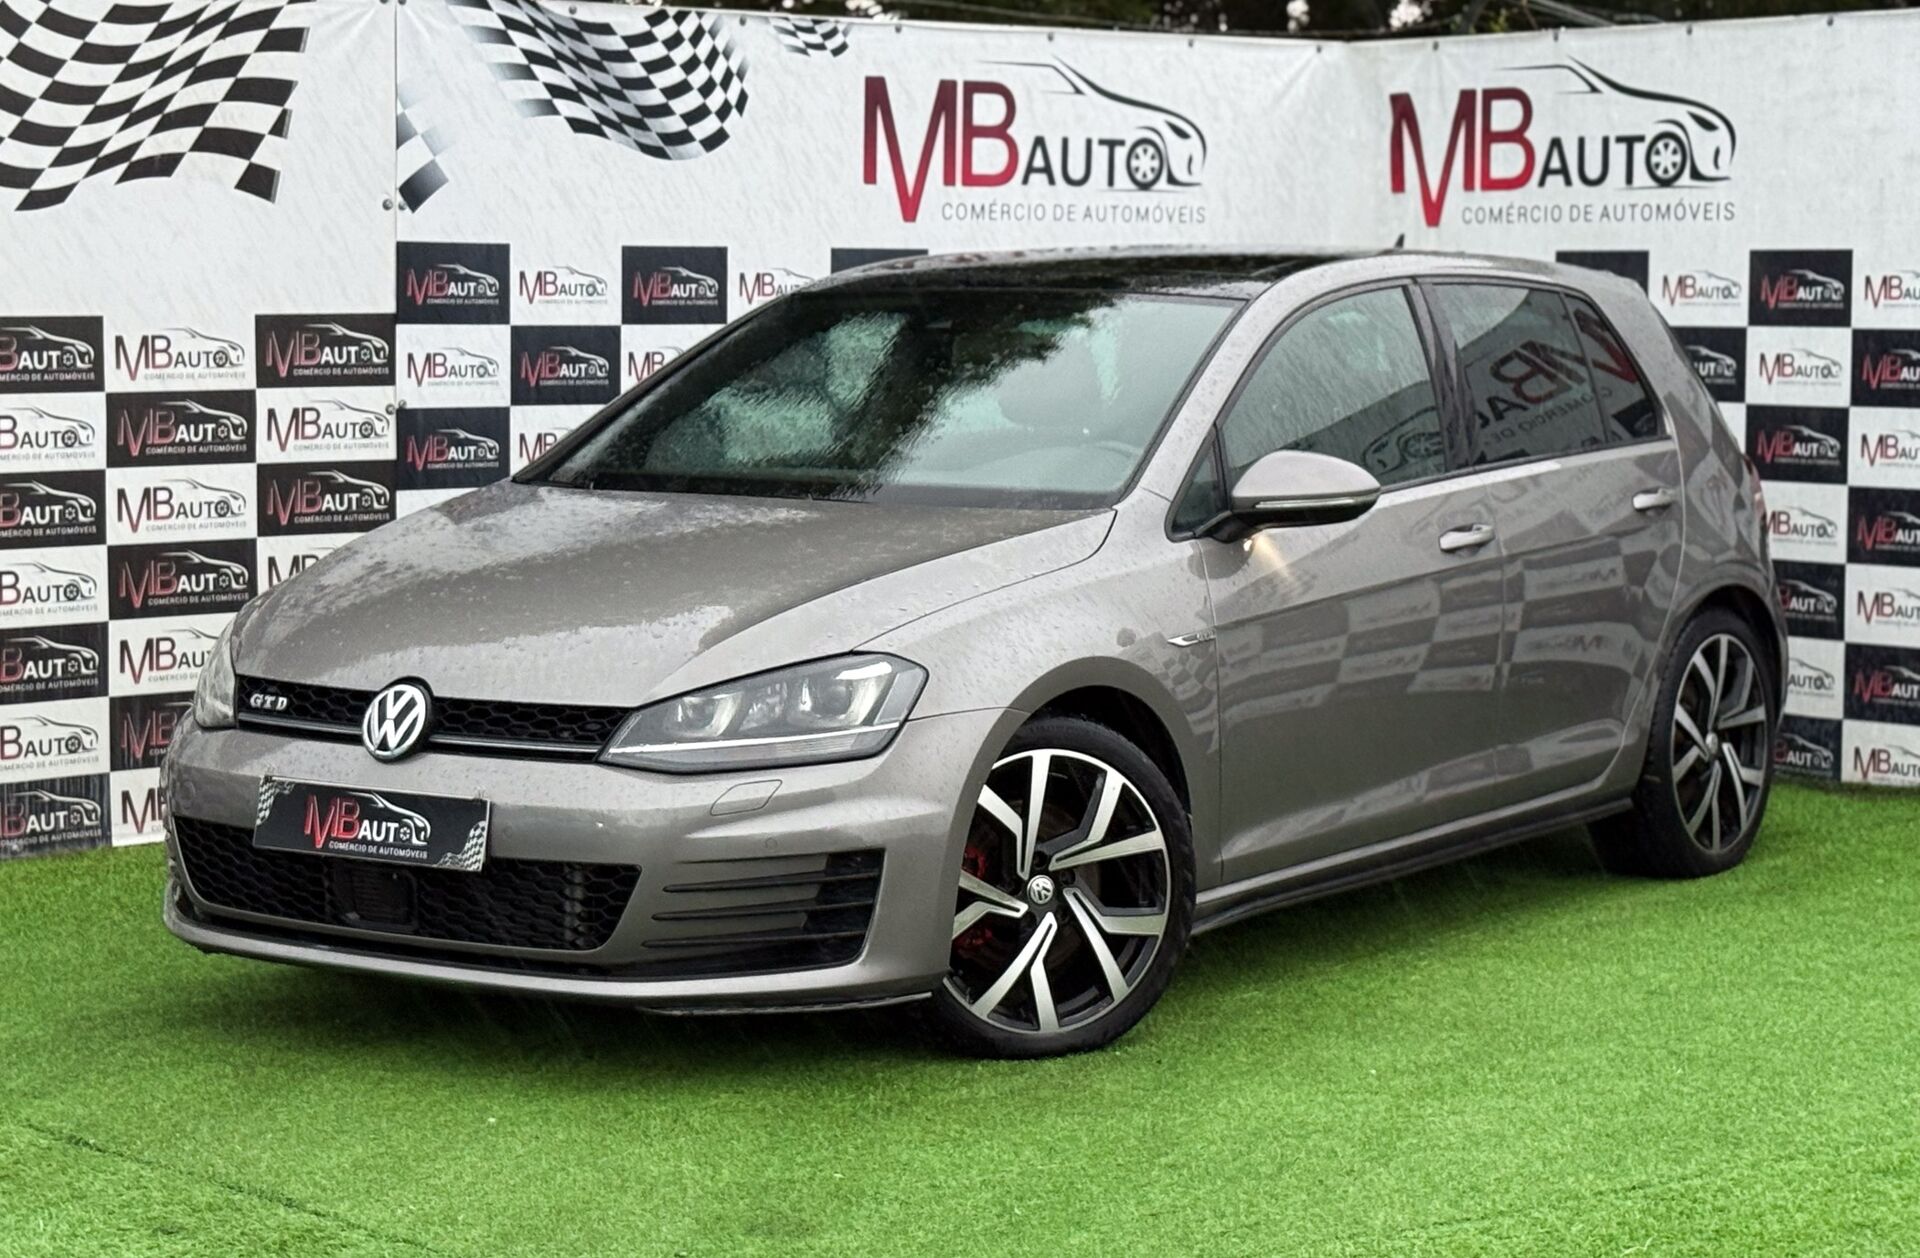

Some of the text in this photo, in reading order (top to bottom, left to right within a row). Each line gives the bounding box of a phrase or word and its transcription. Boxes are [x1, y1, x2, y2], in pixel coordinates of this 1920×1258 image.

[942, 200, 1206, 224] COMÉRCIO DE AUTOMÓVEIS
[1461, 198, 1736, 224] COMÉRCIO DE AUTOMÓVEIS
[250, 693, 288, 711] GTD
[367, 844, 377, 853] DE
